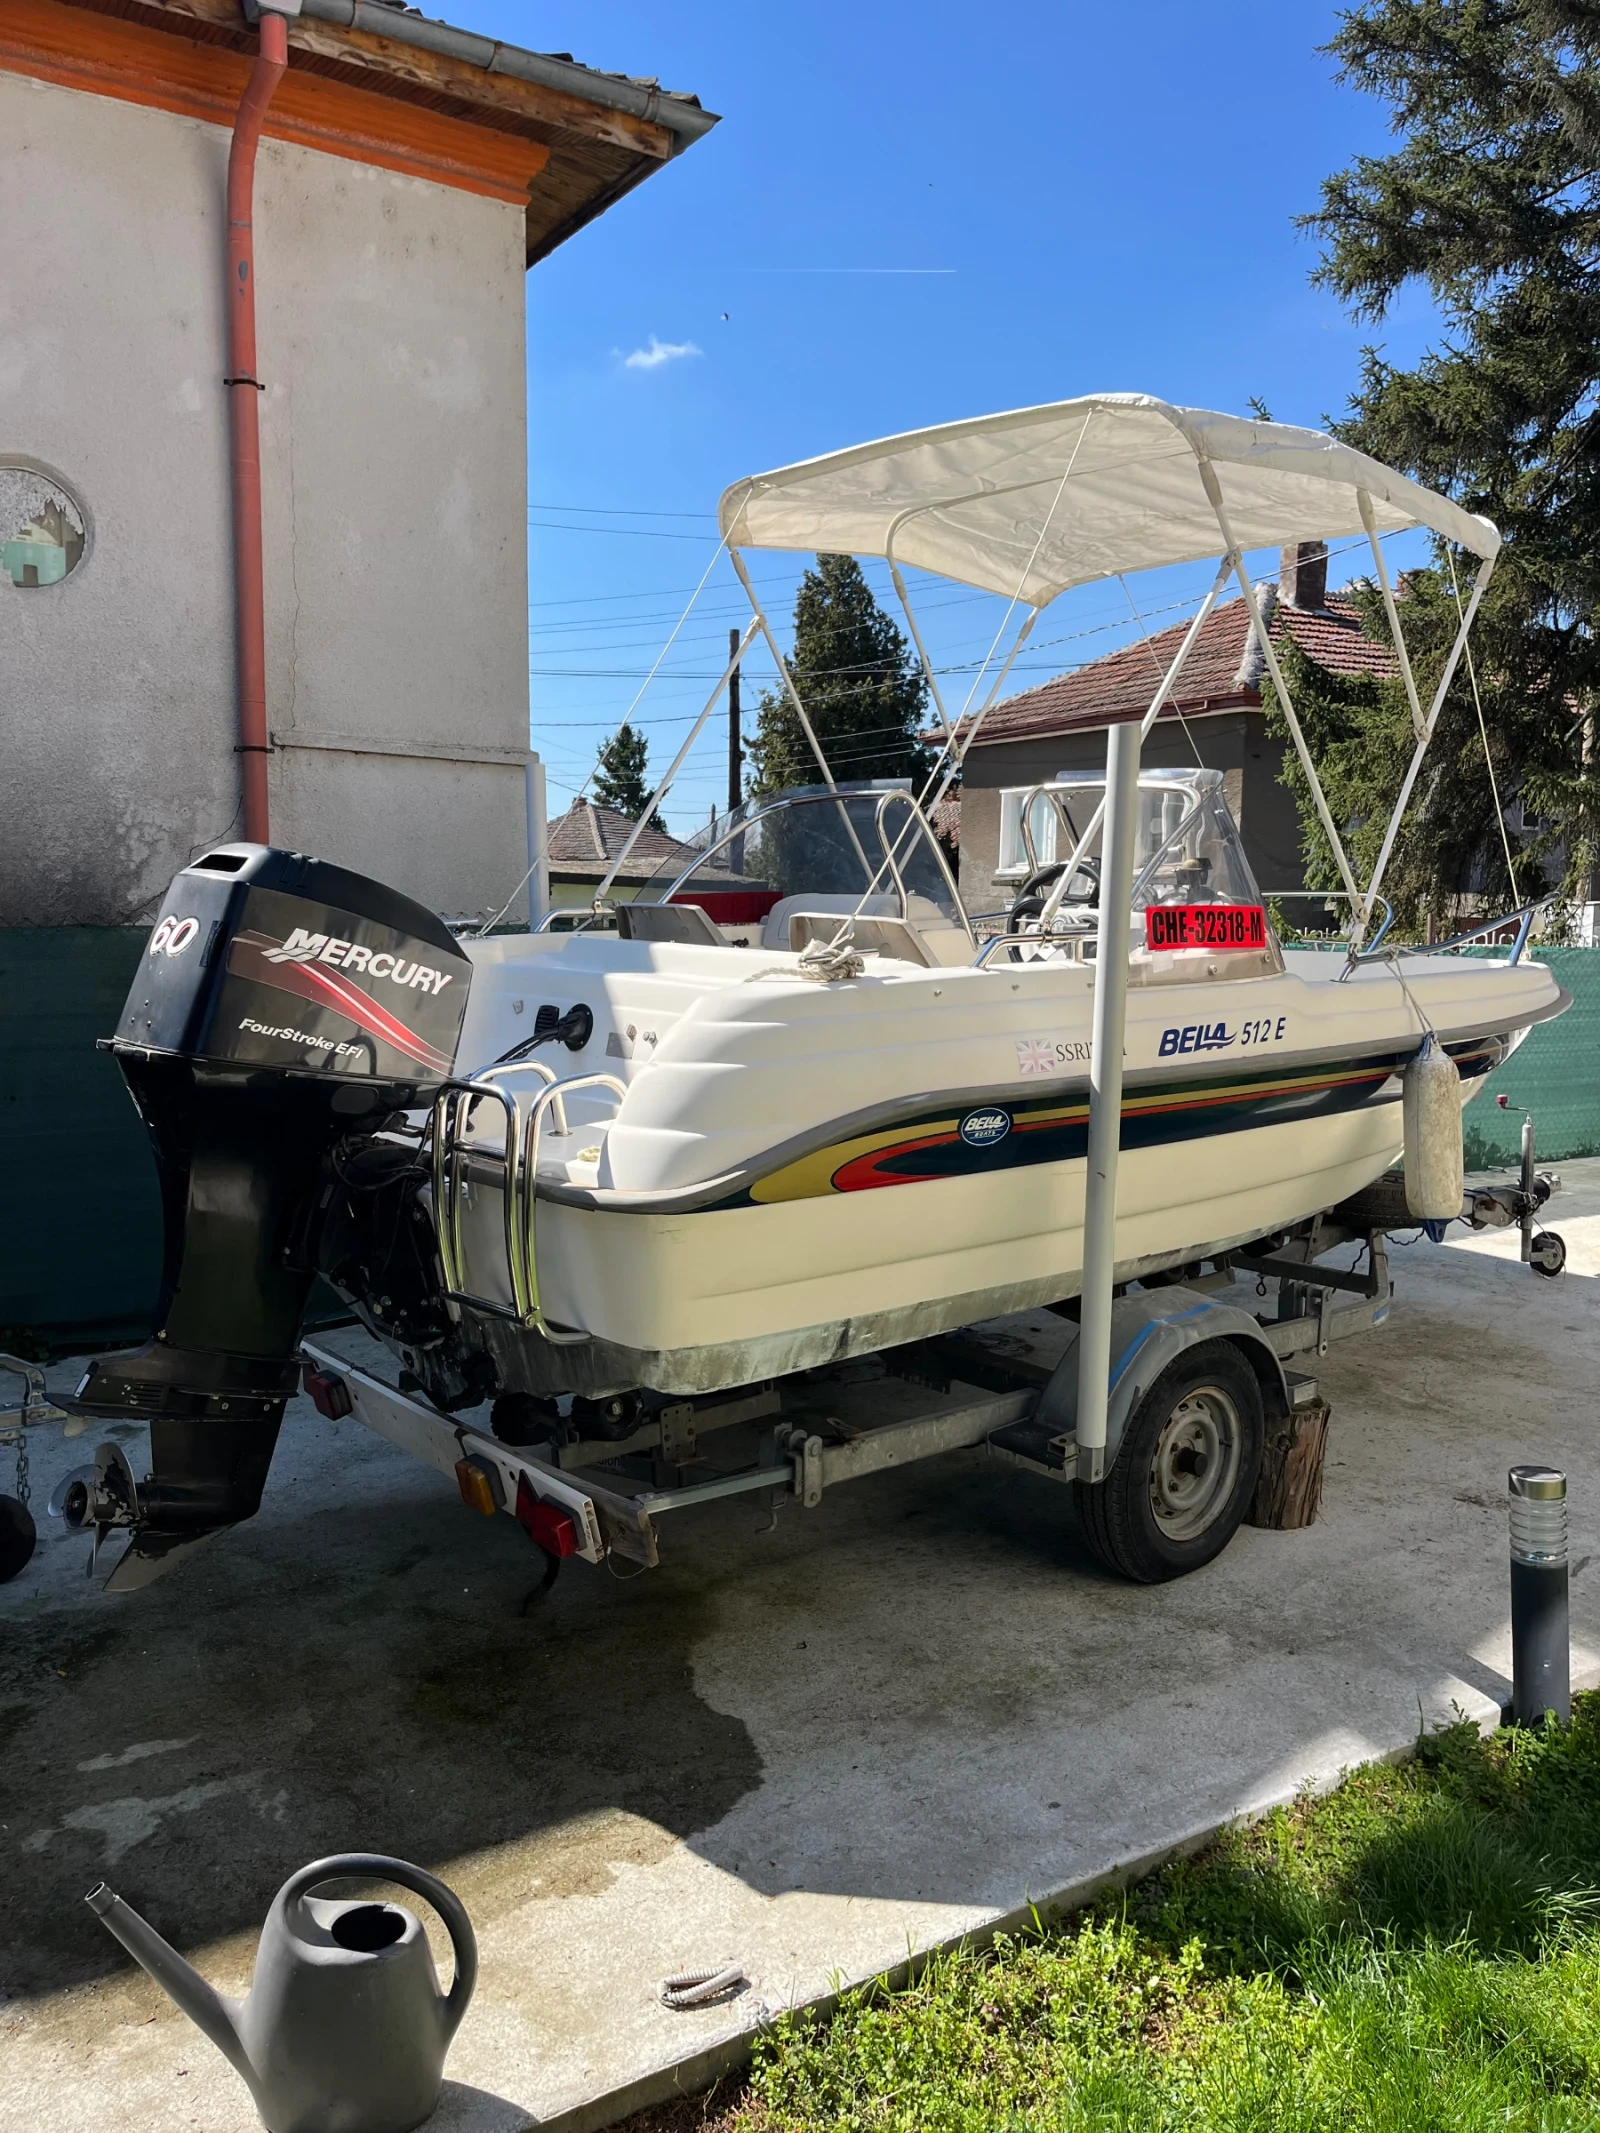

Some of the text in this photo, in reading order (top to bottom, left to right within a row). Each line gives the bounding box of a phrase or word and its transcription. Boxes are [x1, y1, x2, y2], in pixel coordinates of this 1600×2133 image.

[149, 914, 200, 958] 60
[1151, 911, 1263, 945] CHE-32318-M
[276, 927, 453, 996] MERCURY
[238, 1018, 364, 1059] FourStroke EFI
[1158, 1017, 1287, 1057] BELLA 512 E
[964, 1115, 1007, 1131] BELLA
